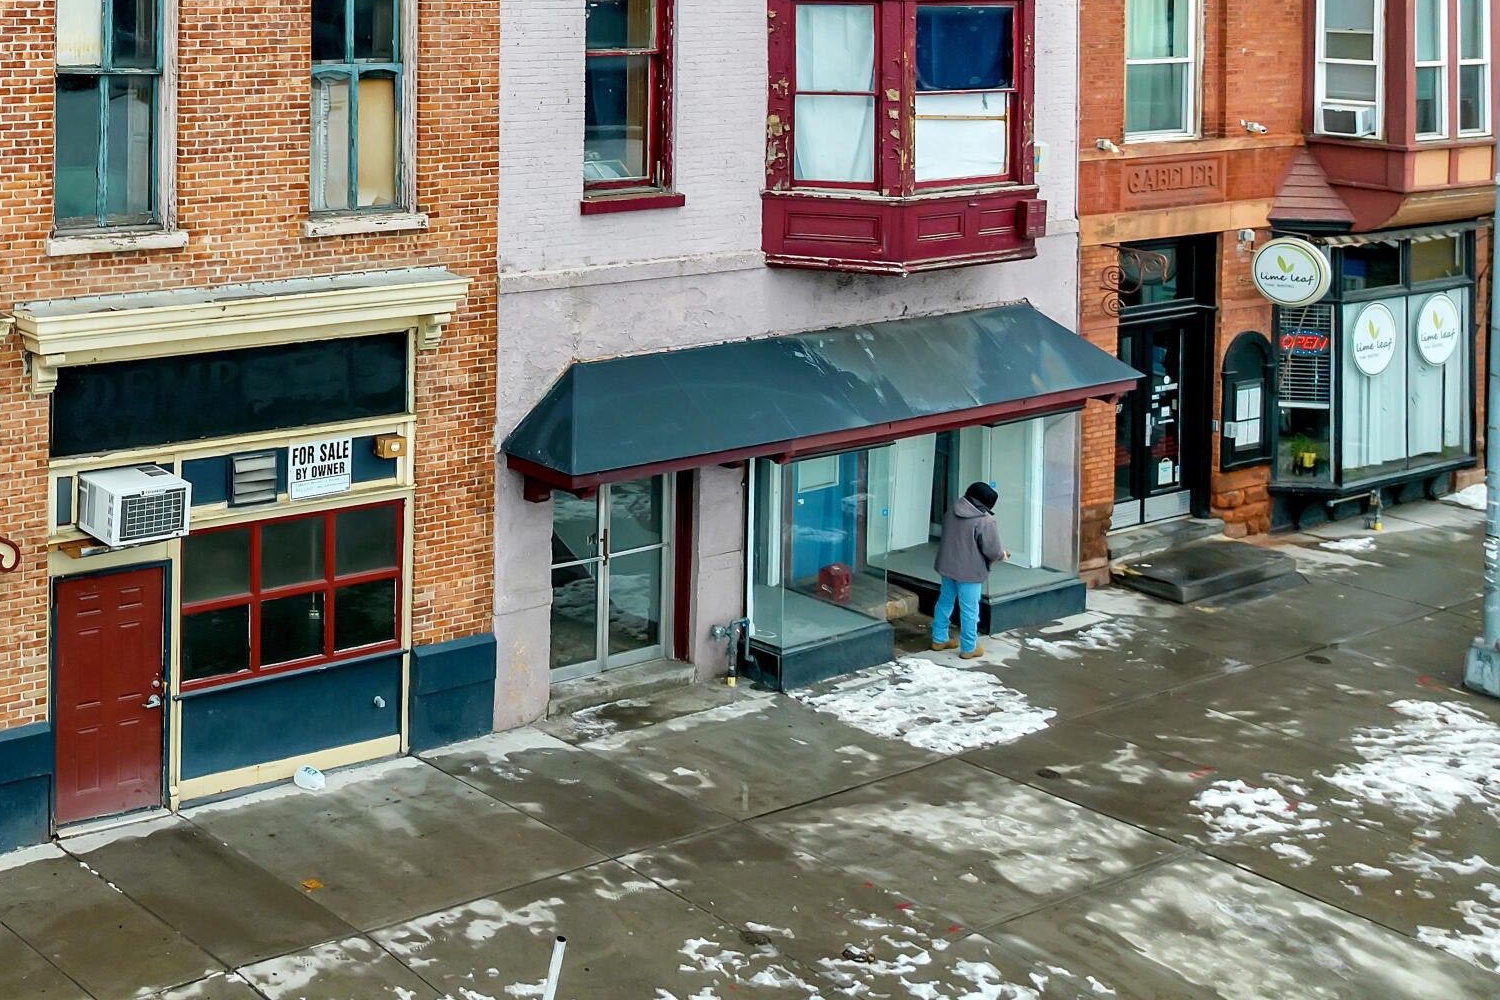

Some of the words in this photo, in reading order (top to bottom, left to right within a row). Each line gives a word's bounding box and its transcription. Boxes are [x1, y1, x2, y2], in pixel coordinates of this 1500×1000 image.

[1280, 334, 1329, 351] OPEN
[292, 445, 315, 467] FOR
[319, 440, 350, 462] SALE
[295, 467, 308, 481] BY
[311, 461, 345, 478] OWNER
